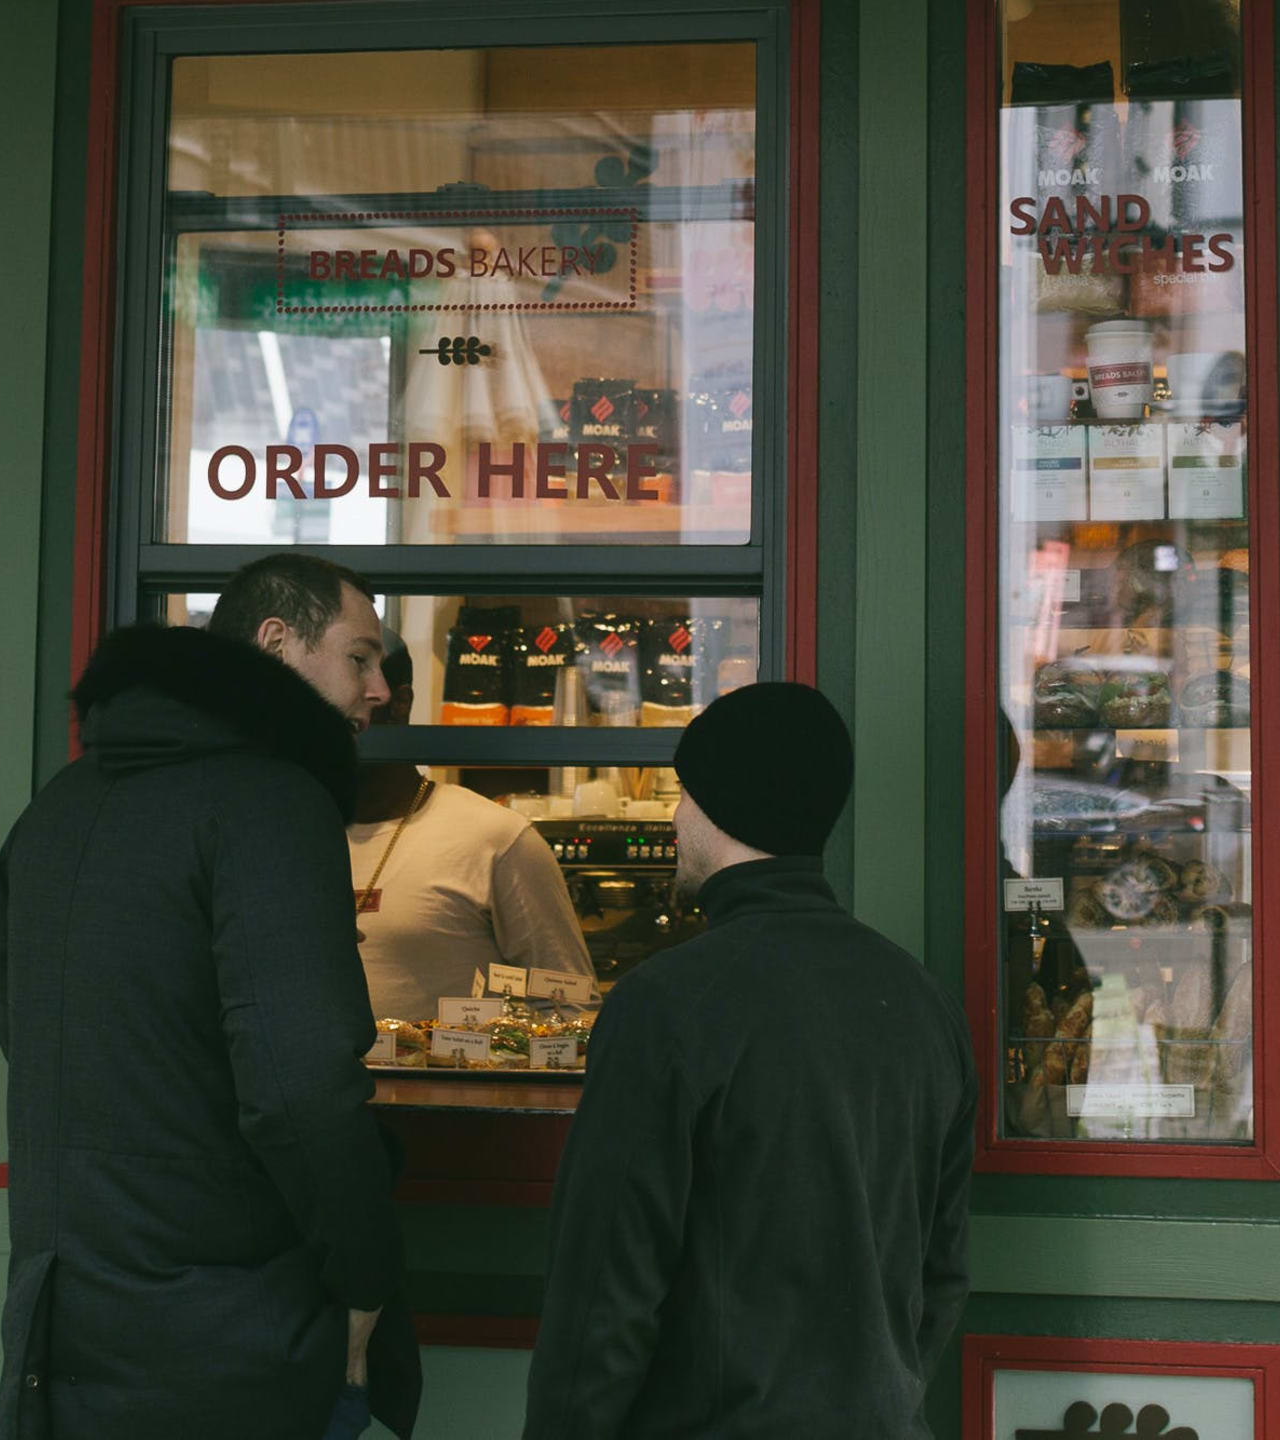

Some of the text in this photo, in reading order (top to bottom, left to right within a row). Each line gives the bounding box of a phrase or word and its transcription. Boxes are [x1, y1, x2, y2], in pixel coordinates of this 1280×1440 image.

[1038, 168, 1100, 186] MOAK
[1153, 165, 1214, 184] MOAK
[1009, 194, 1151, 235] SAND
[1038, 233, 1234, 275] WICHES
[309, 245, 606, 280] BREADS BAKERY
[582, 424, 620, 436] MOAK
[722, 419, 752, 433] MOA
[207, 441, 660, 500] ORDER HERE
[459, 653, 497, 666] MOAK
[526, 653, 565, 667] MOAK
[591, 660, 630, 673] MOAK
[658, 653, 696, 666] MOAK
